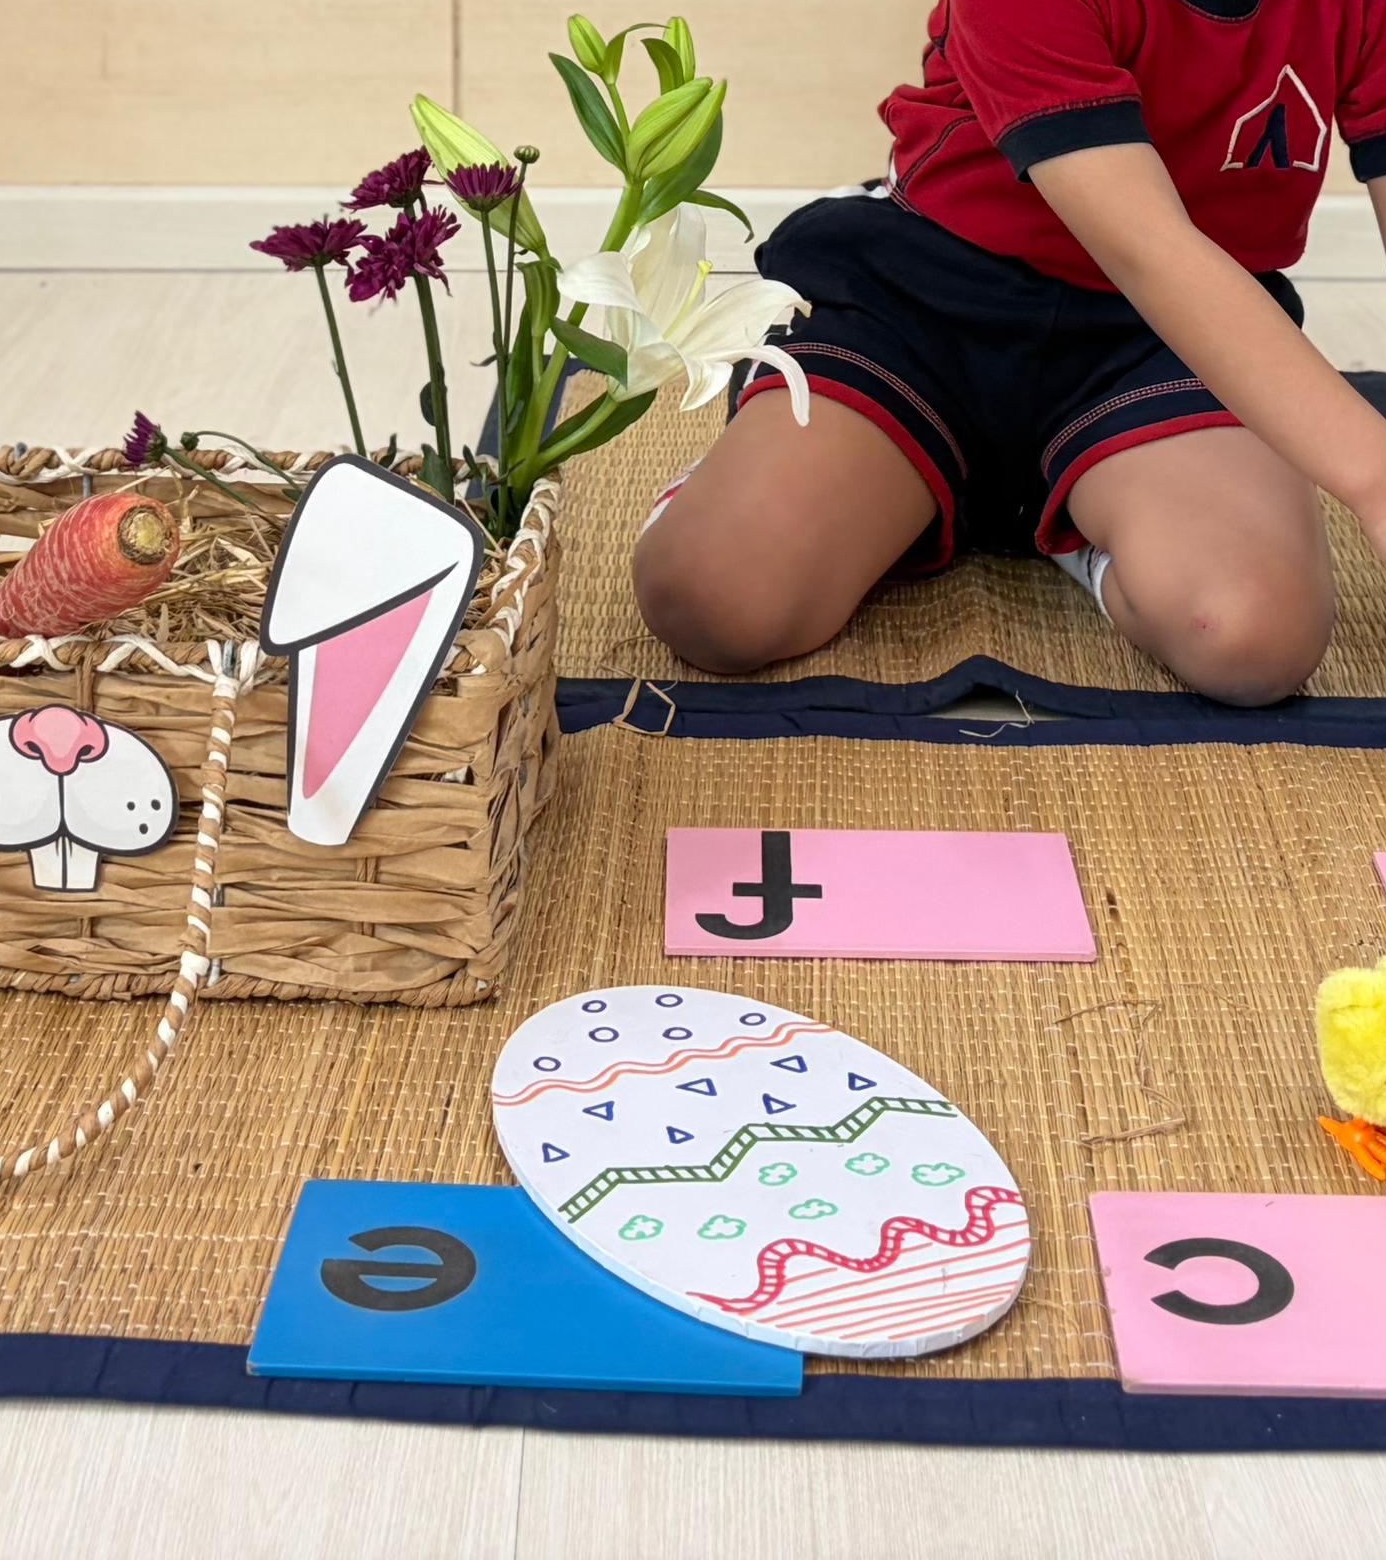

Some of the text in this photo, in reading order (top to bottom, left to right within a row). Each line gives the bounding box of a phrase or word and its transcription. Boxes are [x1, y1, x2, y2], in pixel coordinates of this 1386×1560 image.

[695, 830, 823, 940] f
[320, 1225, 477, 1312] e
[1144, 1237, 1295, 1325] c
